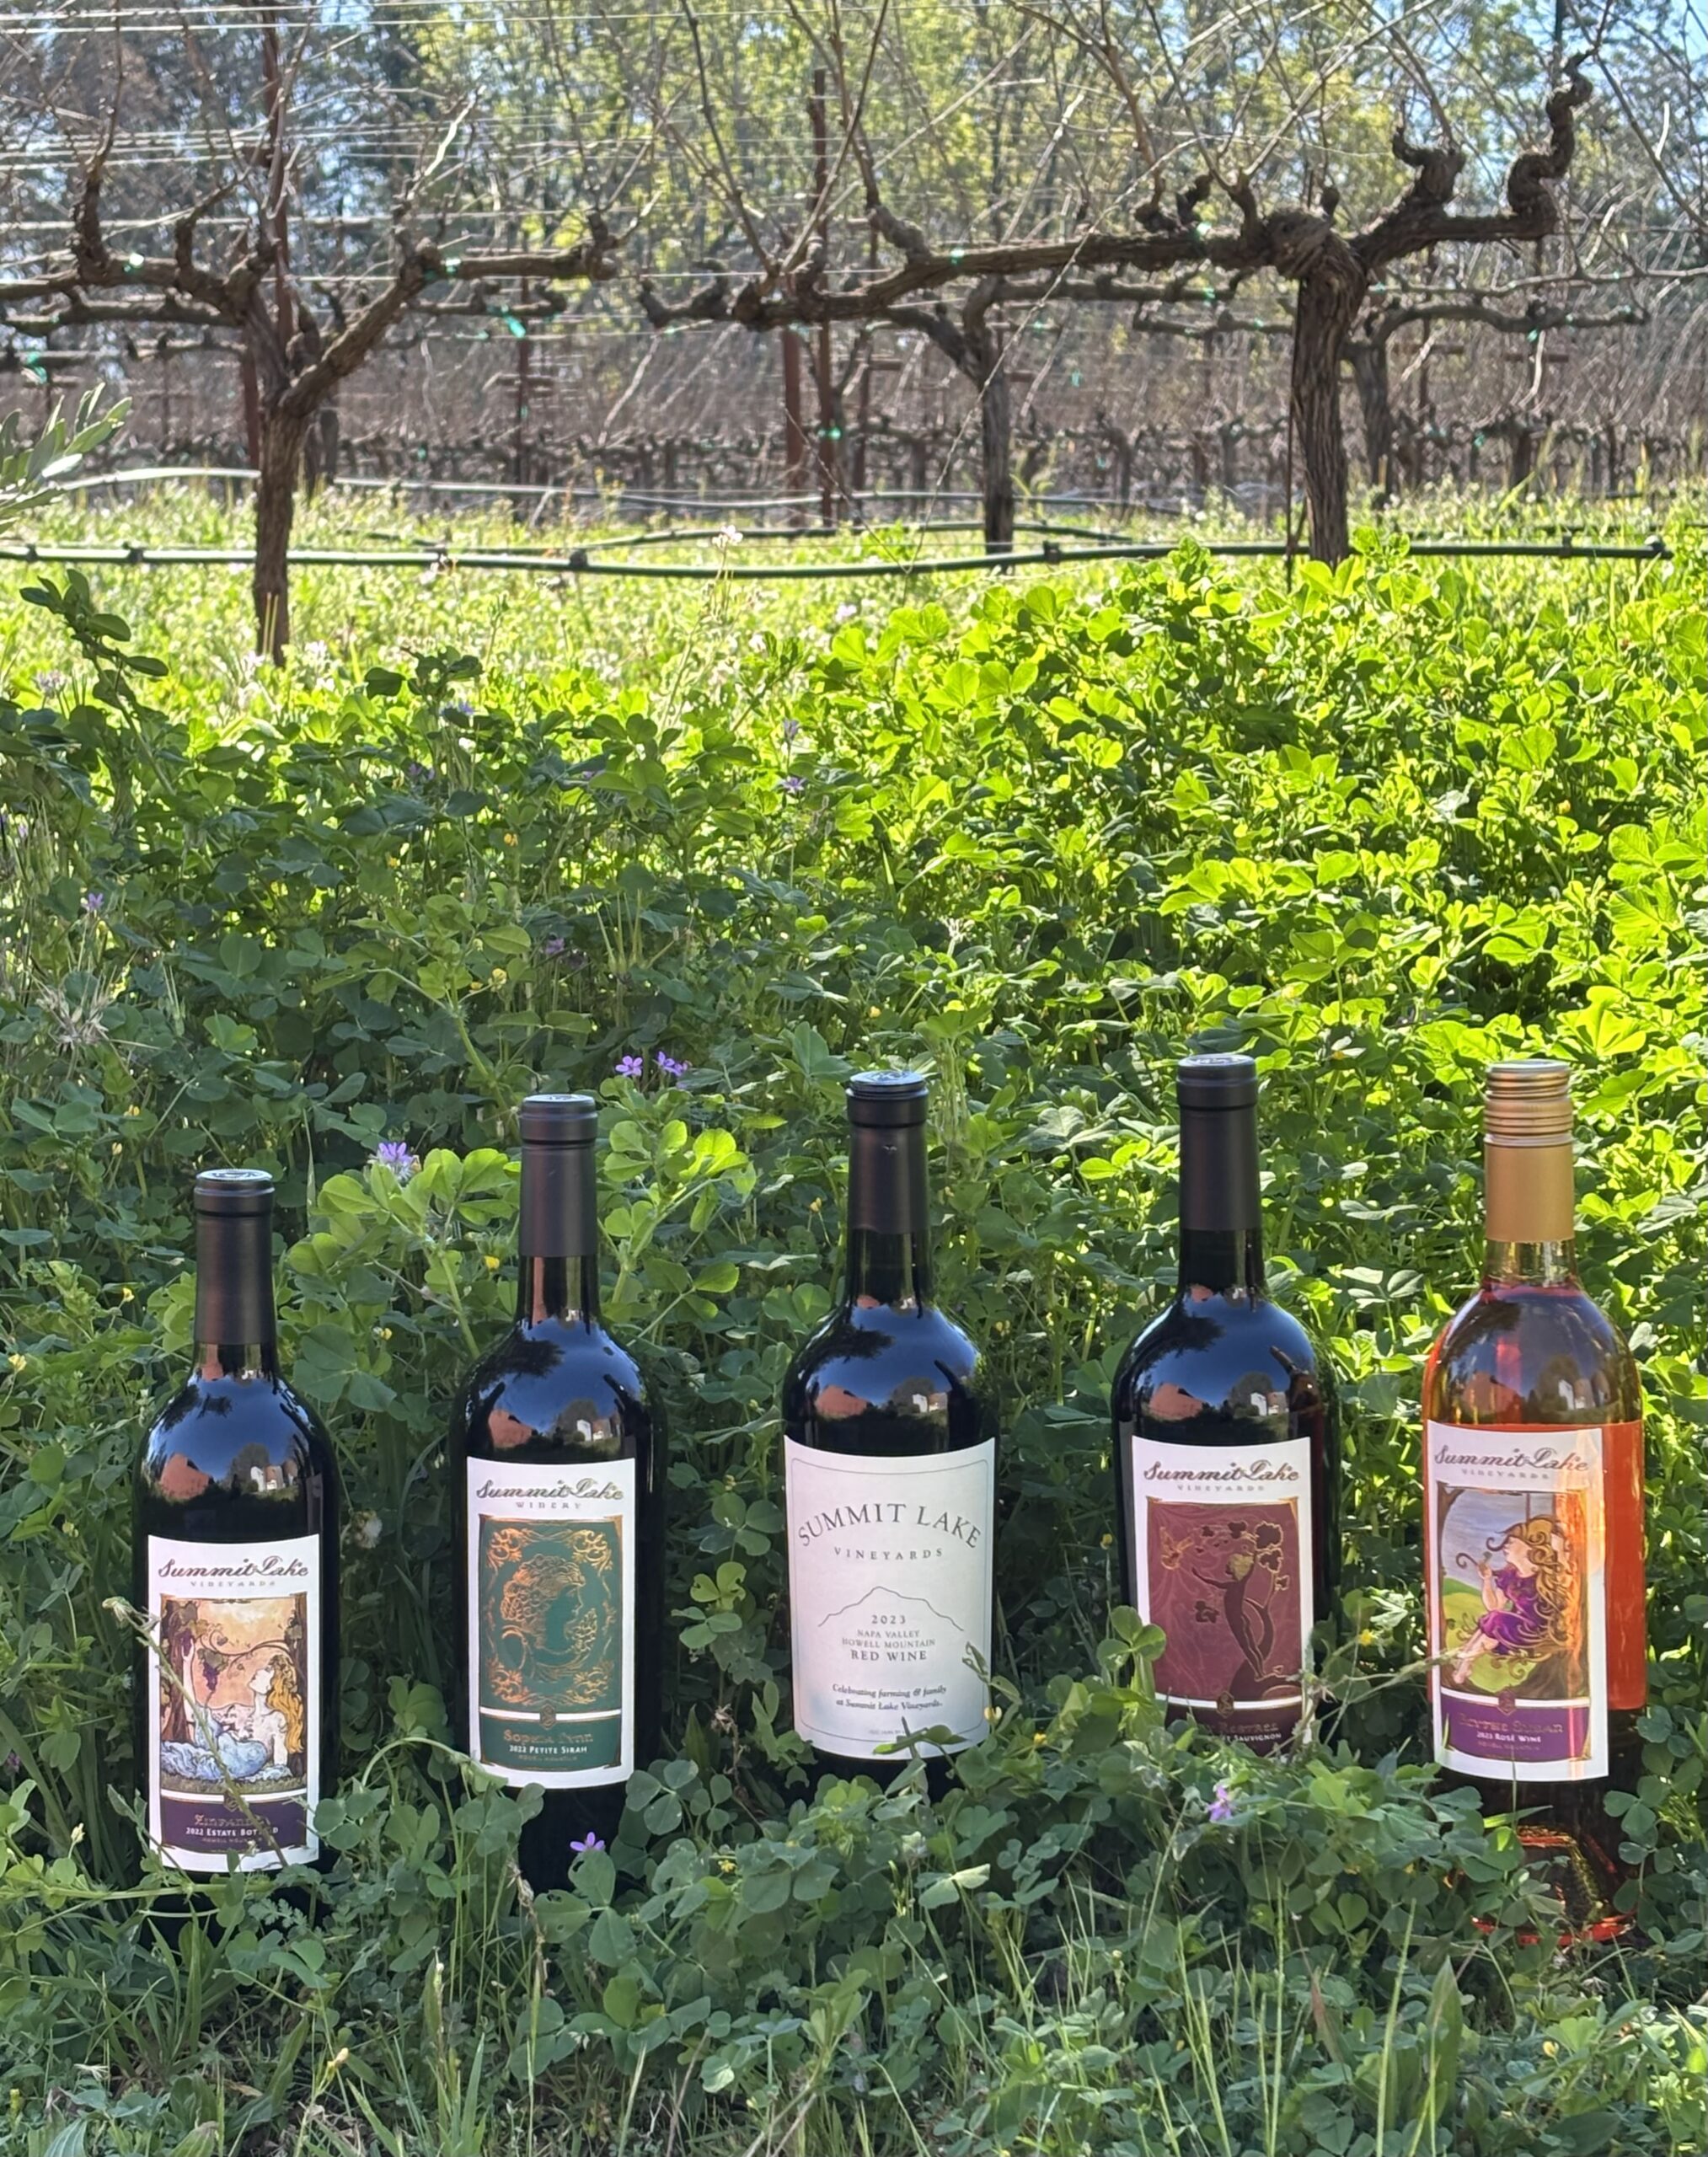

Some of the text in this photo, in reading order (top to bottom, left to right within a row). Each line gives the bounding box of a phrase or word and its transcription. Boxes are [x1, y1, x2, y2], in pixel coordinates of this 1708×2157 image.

[1435, 1444, 1589, 1471] Summit Lake
[1144, 1459, 1299, 1481] Summit Lake
[1462, 1469, 1550, 1480] VINEYARDS
[476, 1478, 624, 1500] Summit Lake
[799, 1503, 981, 1548] SUMMIT LAKE
[834, 1547, 943, 1560] VINEYARDS
[158, 1555, 308, 1577] Summit Lake
[871, 1615, 906, 1624] 2023
[857, 1630, 881, 1638] NAPA
[843, 1638, 936, 1648] HOWELL MOUNTAIN
[851, 1650, 927, 1662] RED WINE
[833, 1683, 876, 1698] Celebrating
[878, 1689, 910, 1699] farming
[924, 1685, 946, 1697] family
[845, 1699, 875, 1710] Summit
[1234, 1732, 1282, 1742] SAUVIGNON
[509, 1744, 587, 1754] 2022 PETITE SIRAH
[185, 1827, 279, 1837] 2022 ESTATE BOTD
